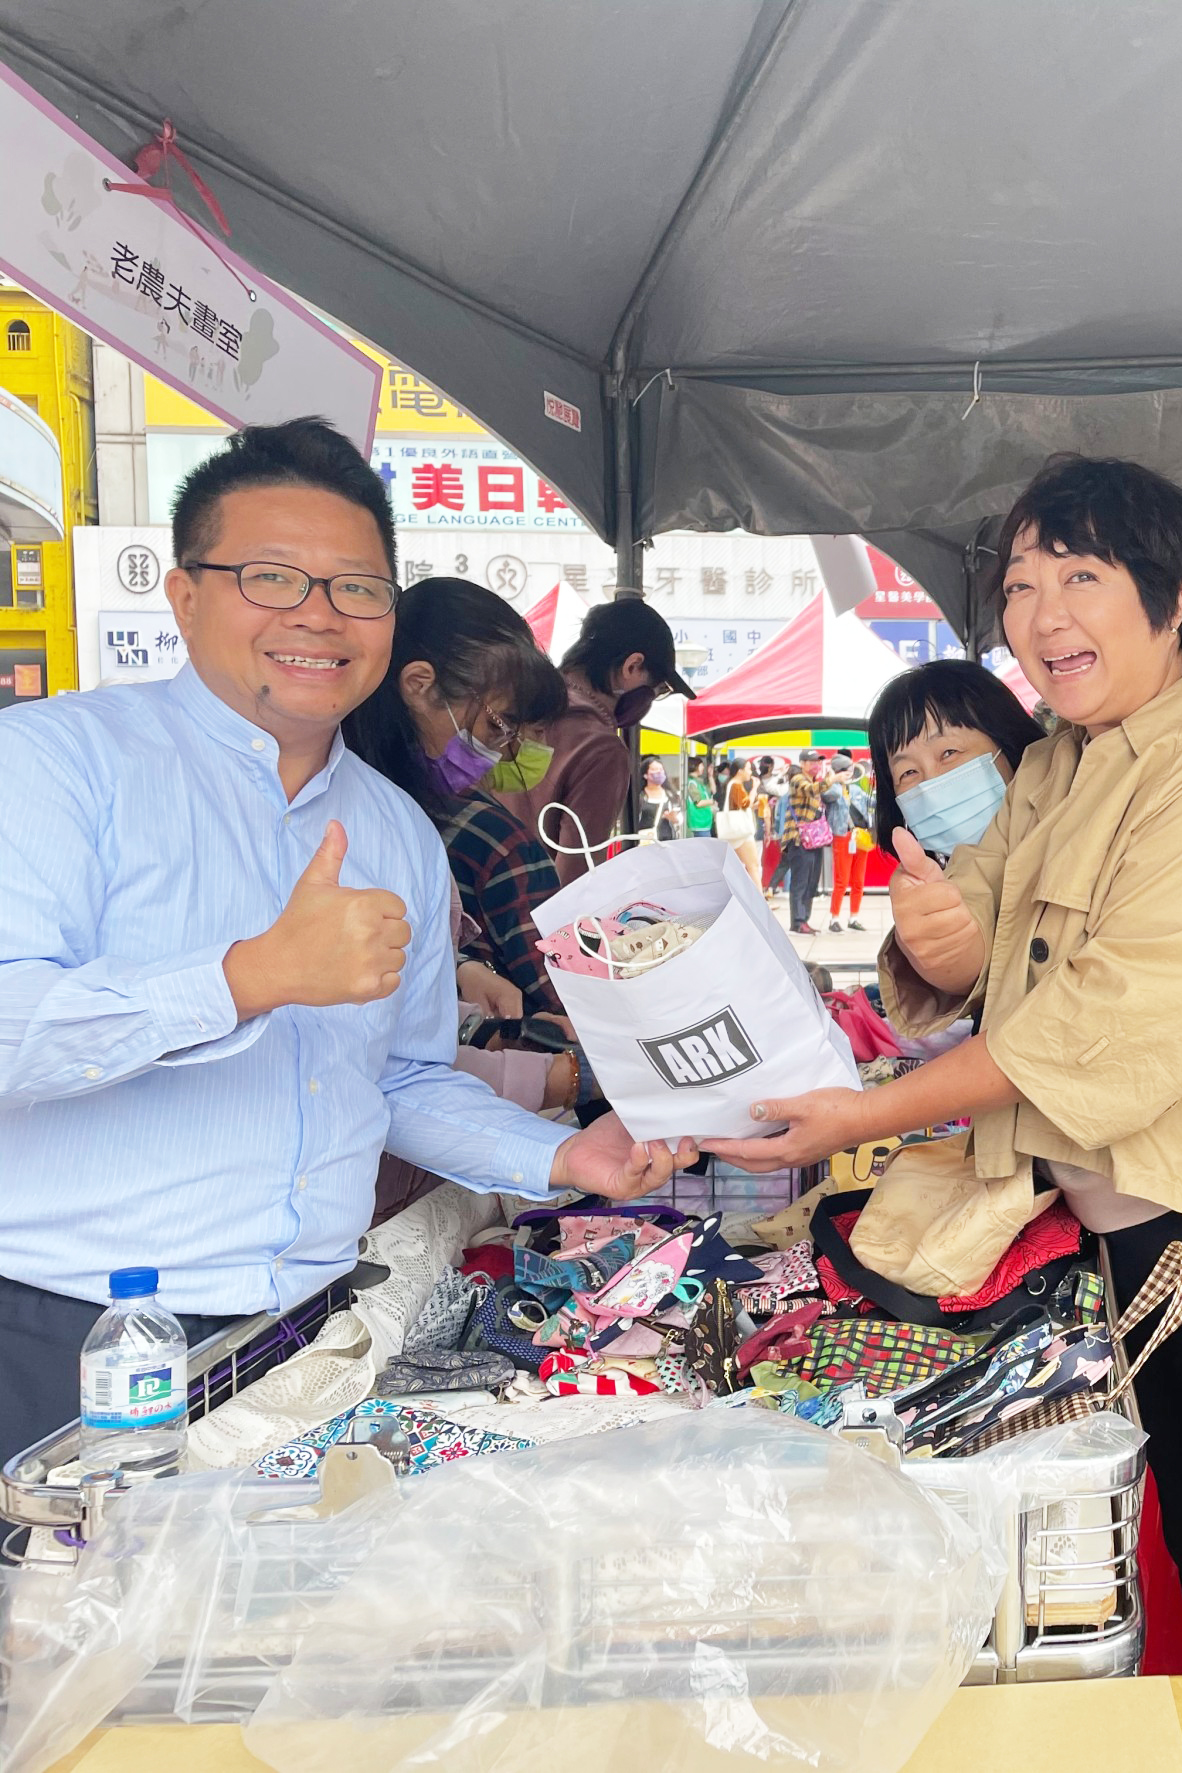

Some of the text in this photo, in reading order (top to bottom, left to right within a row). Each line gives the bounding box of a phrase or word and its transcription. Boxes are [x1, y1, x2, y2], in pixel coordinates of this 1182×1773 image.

[110, 241, 243, 361] 老農夫畫室
[427, 514, 526, 526] LANGUAGE
[533, 516, 588, 527] CENT
[657, 1019, 748, 1084] ARK
